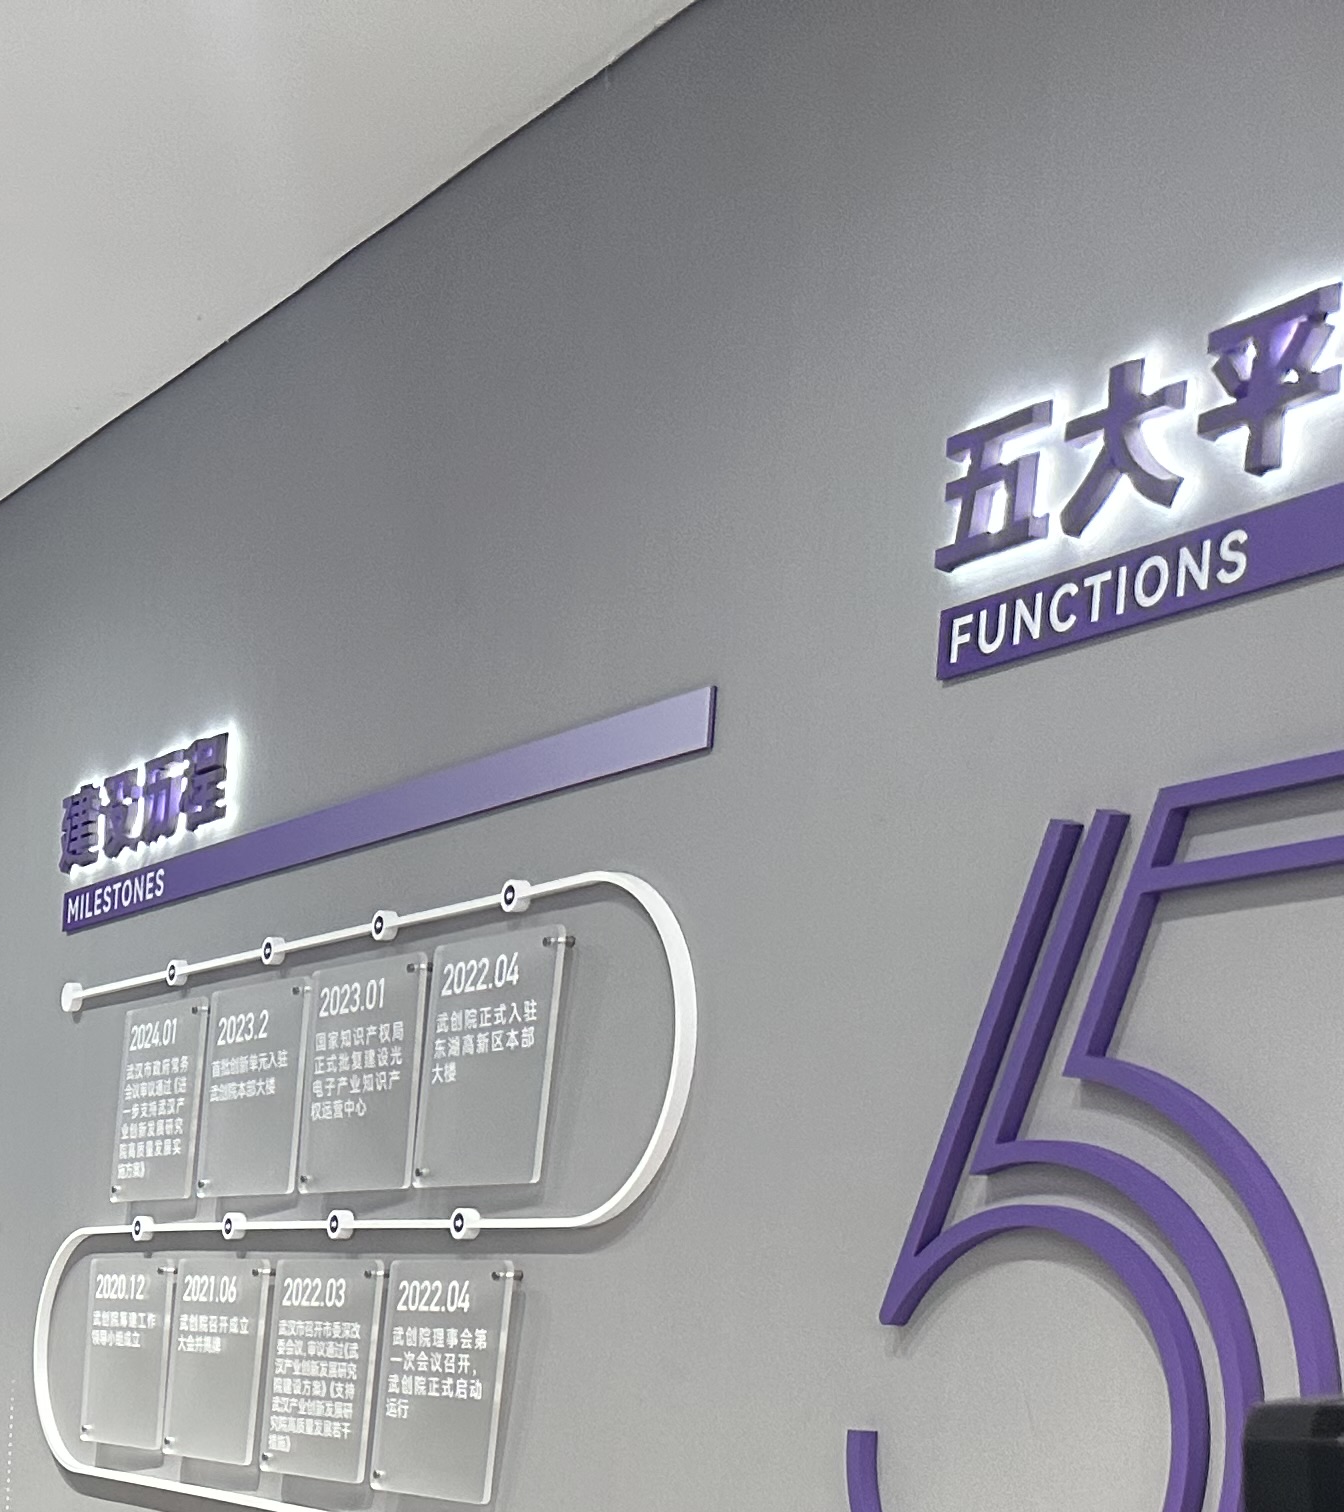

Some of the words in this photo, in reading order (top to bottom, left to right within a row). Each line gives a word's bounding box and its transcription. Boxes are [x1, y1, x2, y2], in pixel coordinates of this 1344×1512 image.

[949, 529, 1249, 663] FUNCTIONS
[60, 733, 229, 874] 建设历程
[66, 869, 165, 923] MILESTONES
[441, 952, 520, 997] 2022.04
[319, 977, 385, 1017] 2023.01
[216, 1009, 269, 1046] 2023.2
[435, 999, 537, 1033] 武创院正式入驻
[129, 1018, 178, 1051] 2024.01
[315, 1021, 404, 1052] 国家知识产权局
[433, 1026, 535, 1059] 东湖高新区本部
[313, 1046, 403, 1075] 正式批复建设光
[432, 1061, 457, 1085] 大楼
[312, 1069, 401, 1098] 电子产业知识产
[310, 1097, 367, 1121] 权运营中心
[95, 1273, 145, 1300] 2020.12
[182, 1274, 237, 1303] 2021.06
[282, 1278, 346, 1307] 2022.03
[396, 1280, 470, 1313] 2022.04
[179, 1313, 249, 1334] 武创院召开成立
[392, 1326, 487, 1350] 武创院理事会第
[387, 1374, 483, 1400] 武创院正式启动
[385, 1397, 409, 1419] 运行
